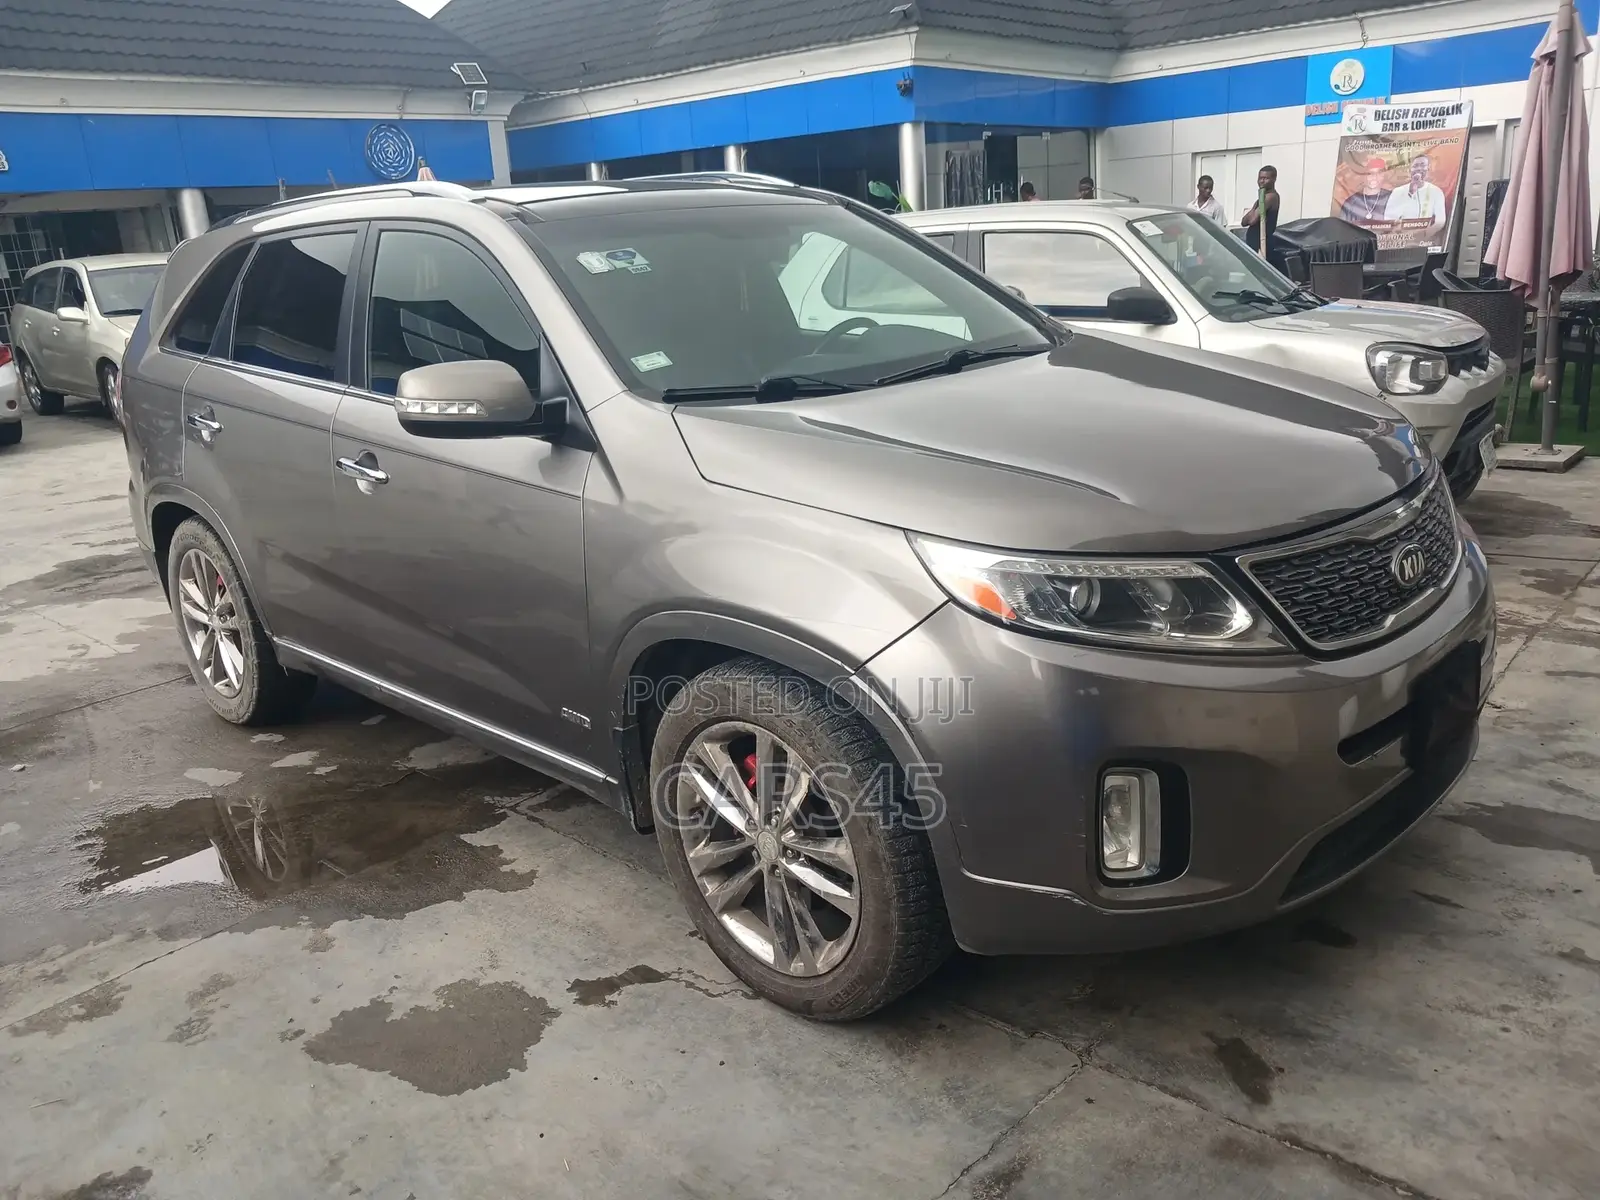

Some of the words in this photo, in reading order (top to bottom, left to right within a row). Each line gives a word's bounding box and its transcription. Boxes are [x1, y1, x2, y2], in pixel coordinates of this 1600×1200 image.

[1374, 108, 1411, 121] DELISH
[1411, 103, 1463, 118] REPUBLIK
[1381, 121, 1401, 132] BAR
[1402, 123, 1409, 131] &
[1411, 119, 1447, 131] LOUNGE
[1440, 137, 1460, 145] BAND
[1402, 550, 1425, 580] KIA
